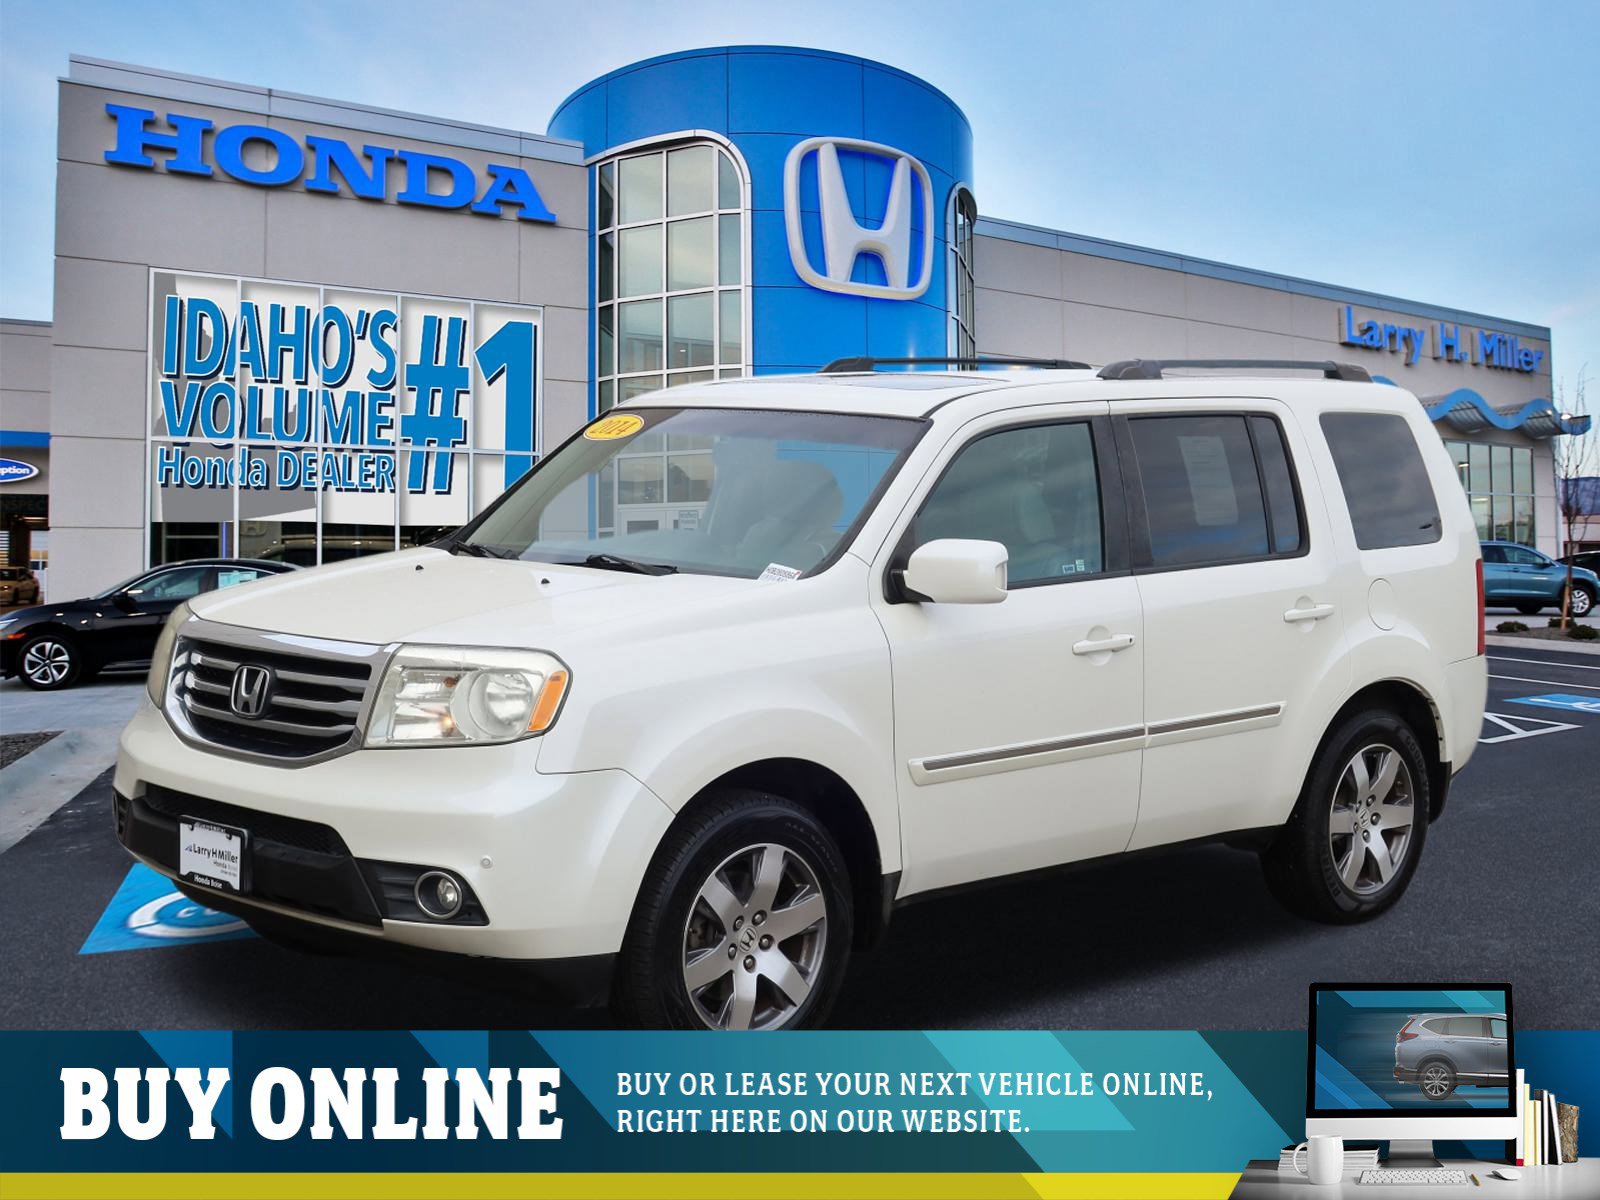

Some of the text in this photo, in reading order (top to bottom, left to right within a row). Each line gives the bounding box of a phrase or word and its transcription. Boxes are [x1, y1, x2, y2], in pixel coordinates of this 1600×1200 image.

[104, 103, 557, 224] HONDA
[162, 294, 399, 391] IDAHO'S
[1341, 304, 1544, 373] Larry H. Miller
[159, 379, 397, 450] VOLUME
[400, 315, 537, 495] #1
[0, 465, 31, 476] ption
[157, 446, 397, 493] Honda DEALER
[193, 843, 211, 859] Larry
[217, 850, 239, 863] Miller
